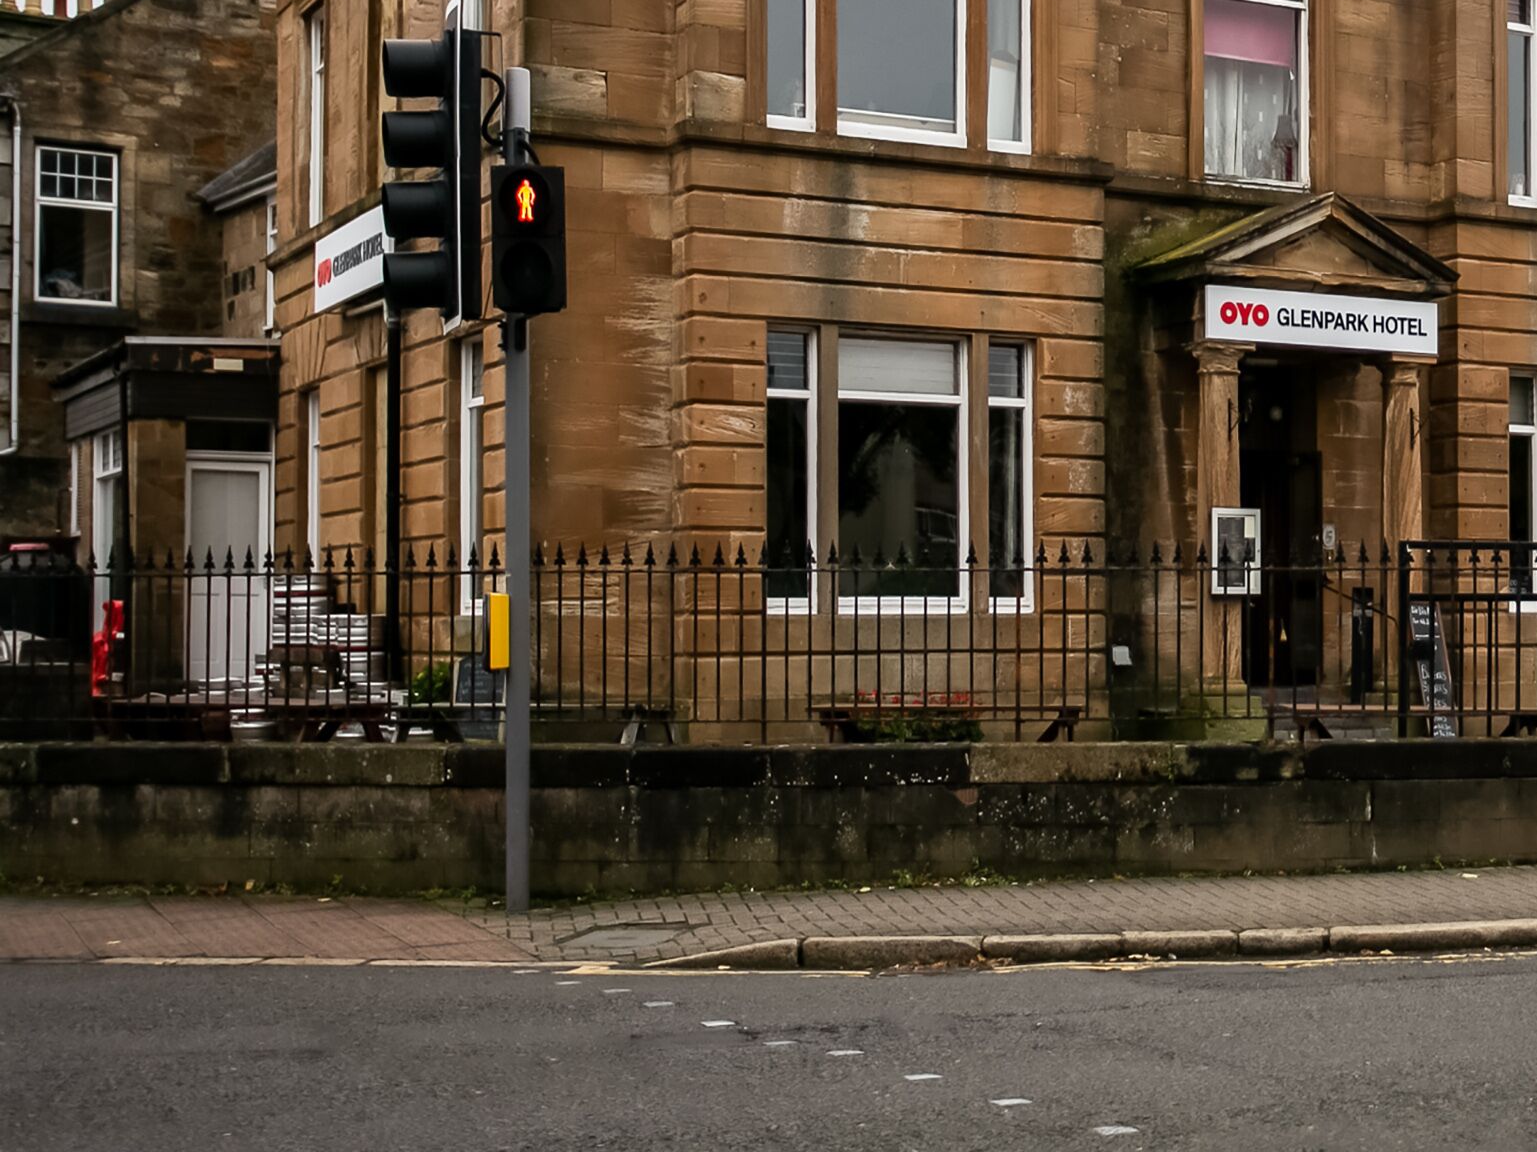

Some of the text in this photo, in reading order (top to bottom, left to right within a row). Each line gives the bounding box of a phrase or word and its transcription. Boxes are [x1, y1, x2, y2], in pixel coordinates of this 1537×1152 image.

[1220, 301, 1428, 336] OYO GLENPARK HOTEL
